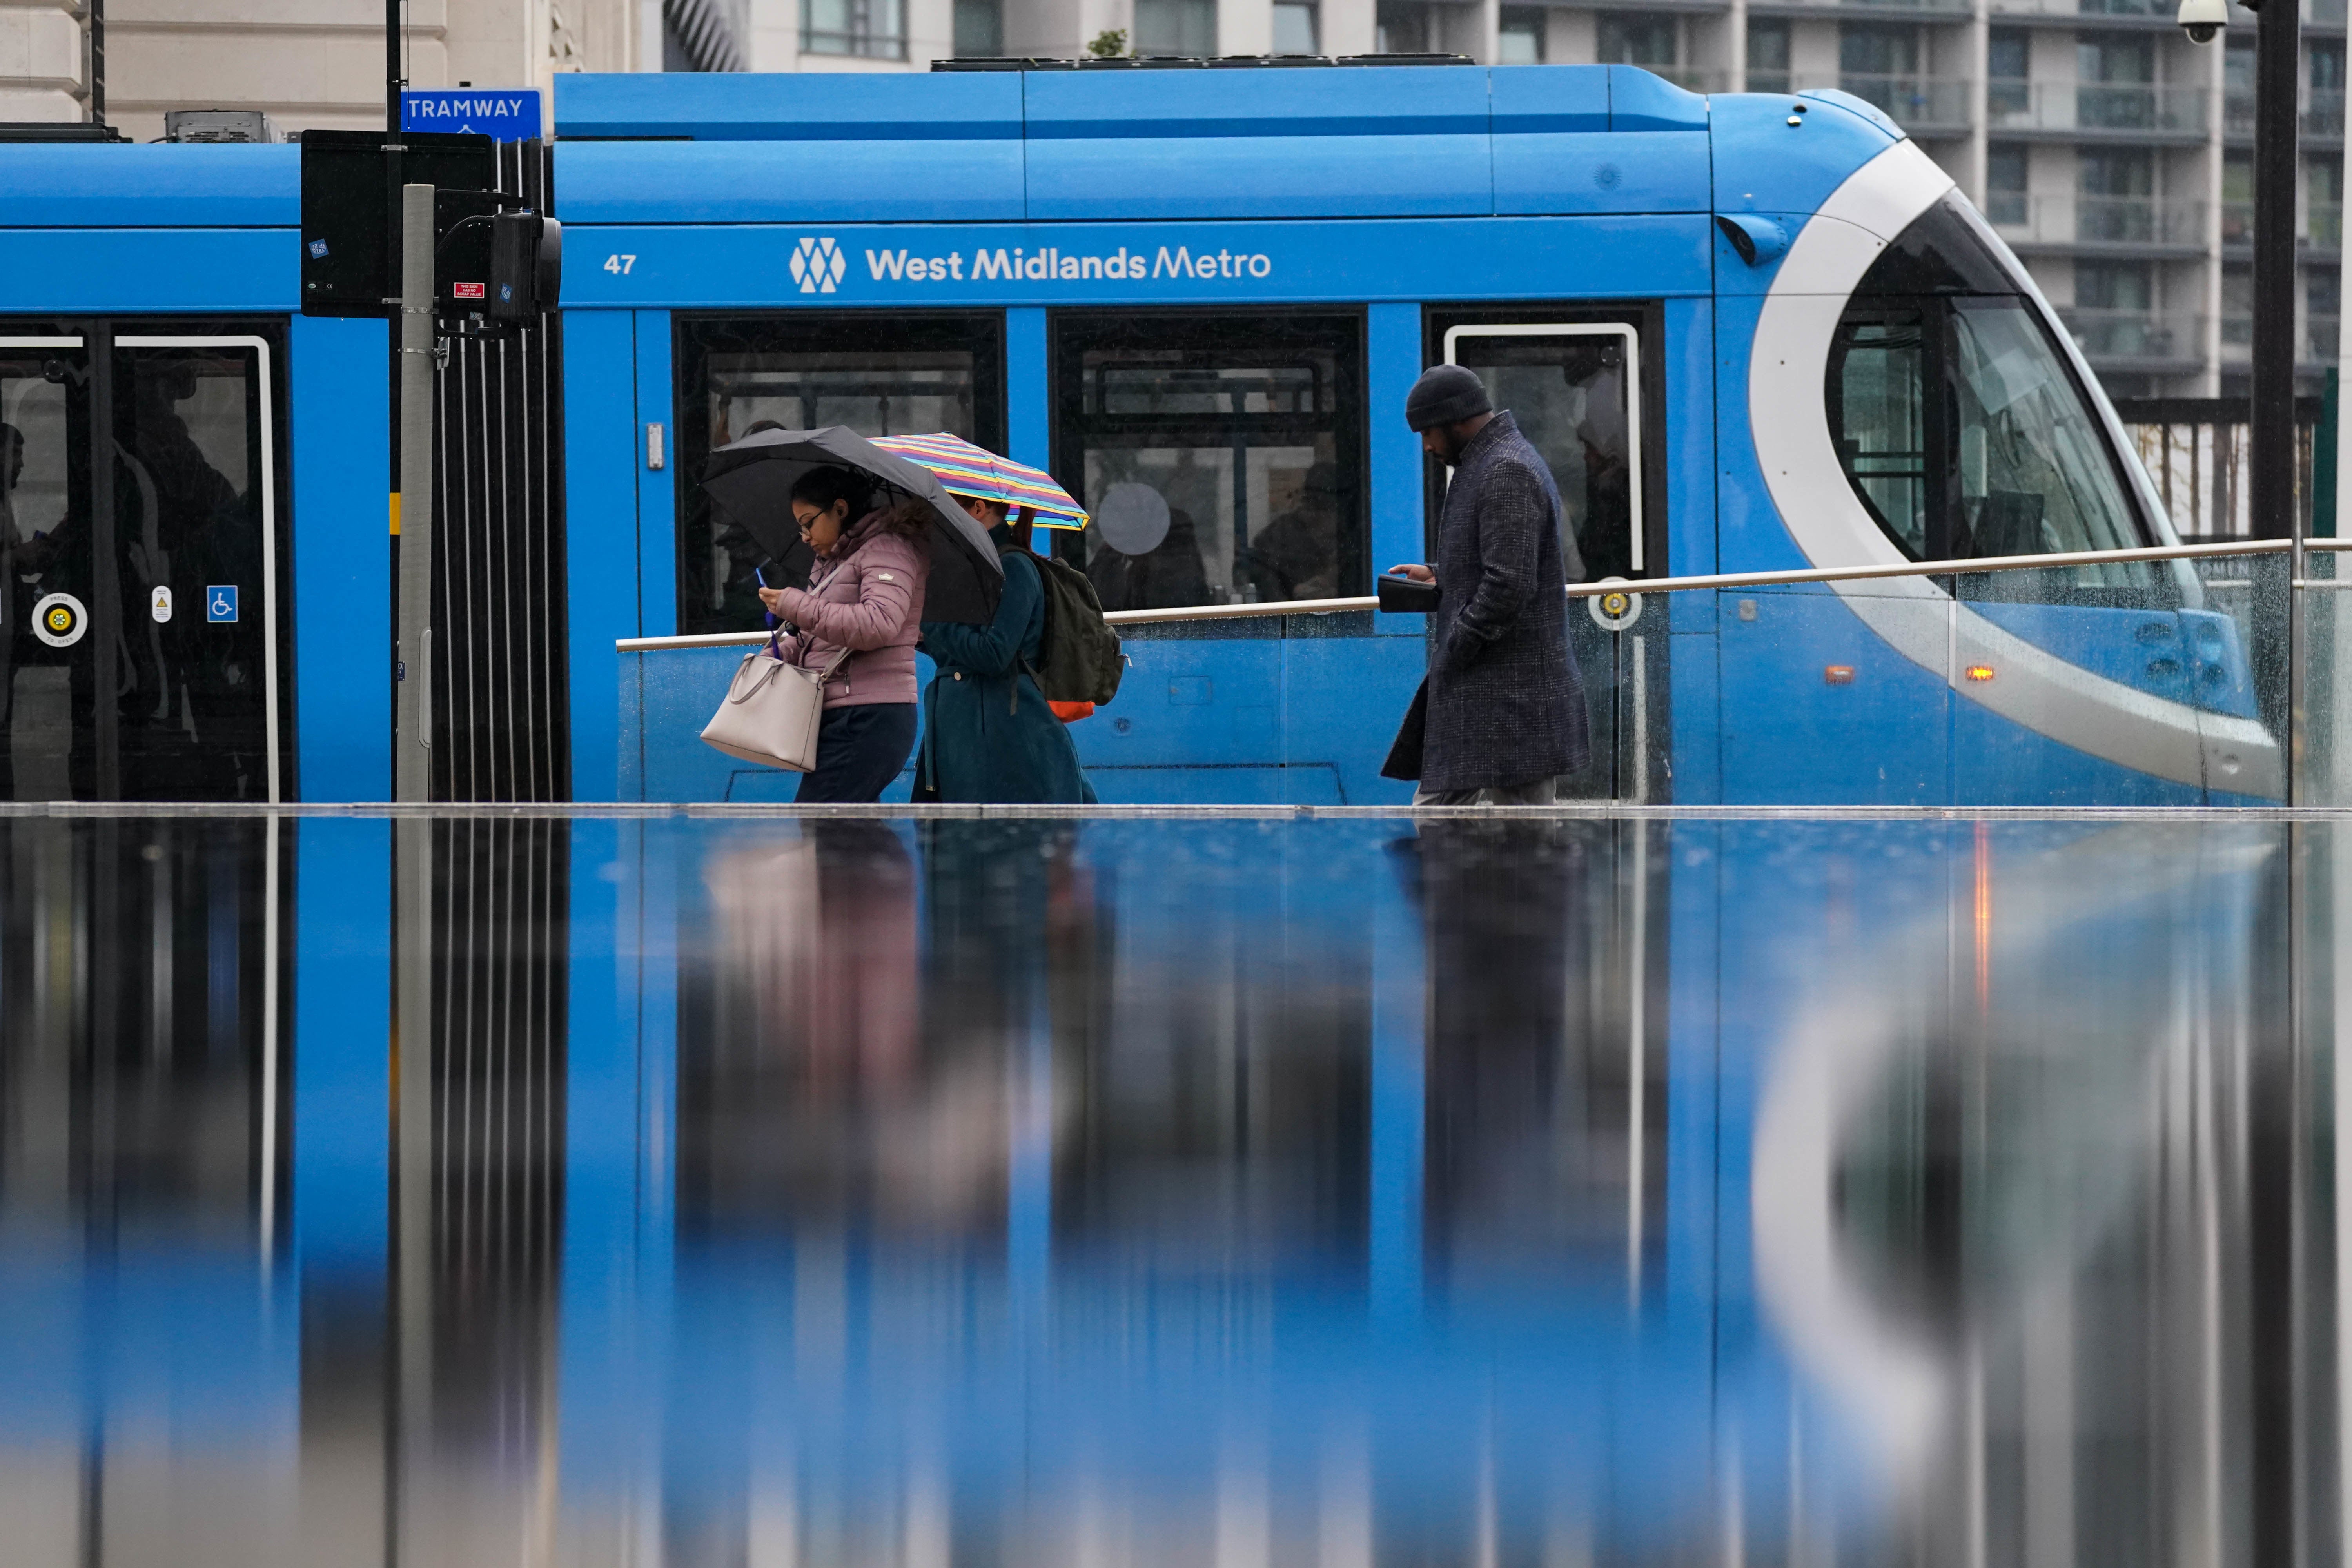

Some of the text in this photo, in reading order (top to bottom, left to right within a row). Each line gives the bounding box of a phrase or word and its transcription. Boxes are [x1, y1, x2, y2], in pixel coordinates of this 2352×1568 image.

[408, 99, 522, 117] TRAMWAY
[604, 254, 636, 274] 47
[865, 246, 1271, 281] West Midlands Metro
